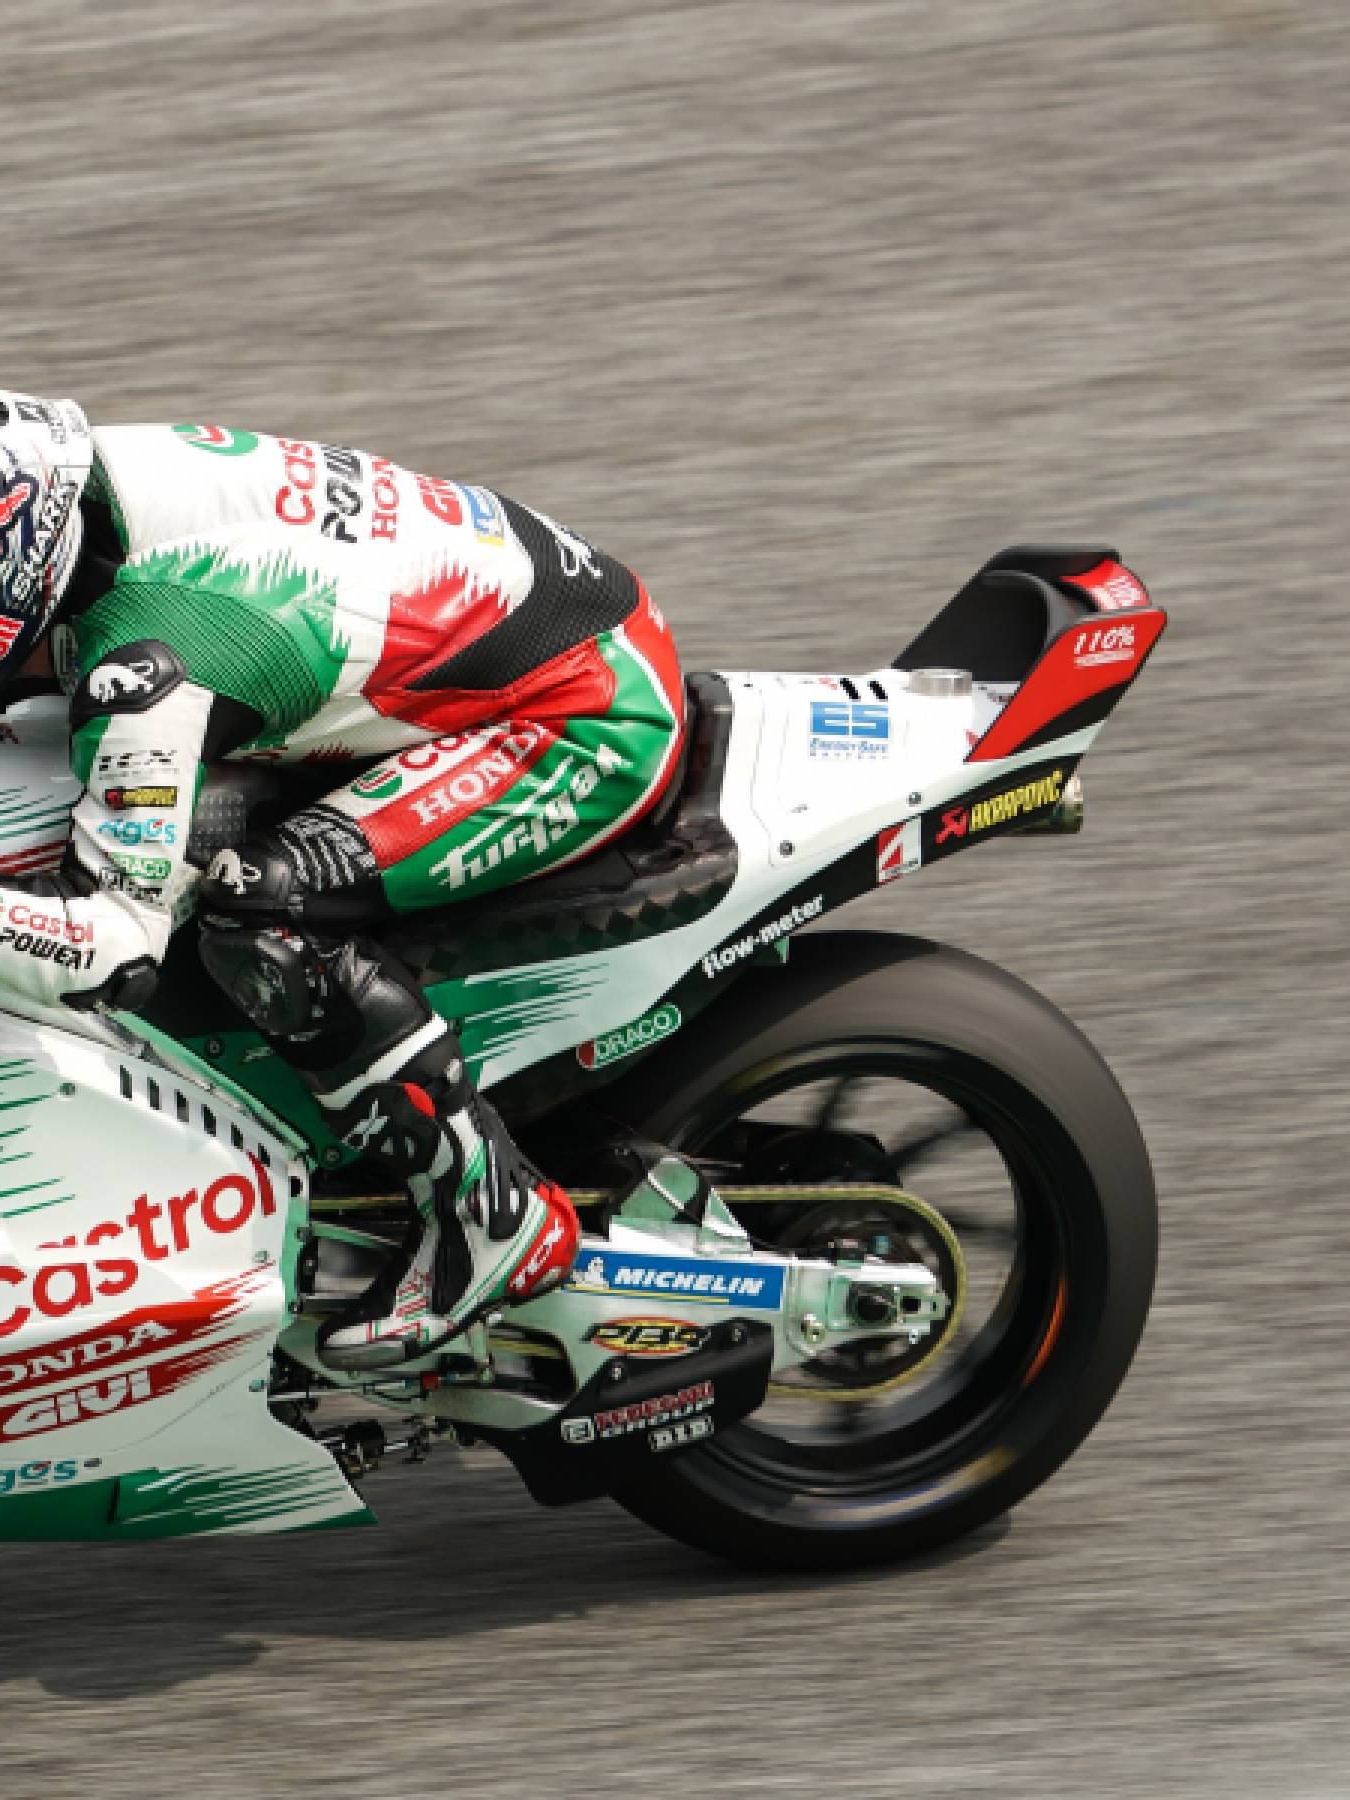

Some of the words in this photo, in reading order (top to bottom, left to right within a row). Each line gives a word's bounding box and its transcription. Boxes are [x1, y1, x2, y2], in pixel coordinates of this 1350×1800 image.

[1074, 625, 1136, 655] 110%
[810, 702, 889, 738] ES
[701, 894, 823, 979] flow-meter
[595, 1008, 672, 1060] DRACO
[614, 1266, 765, 1297] MICHELIN
[2, 1368, 152, 1435] GIVI
